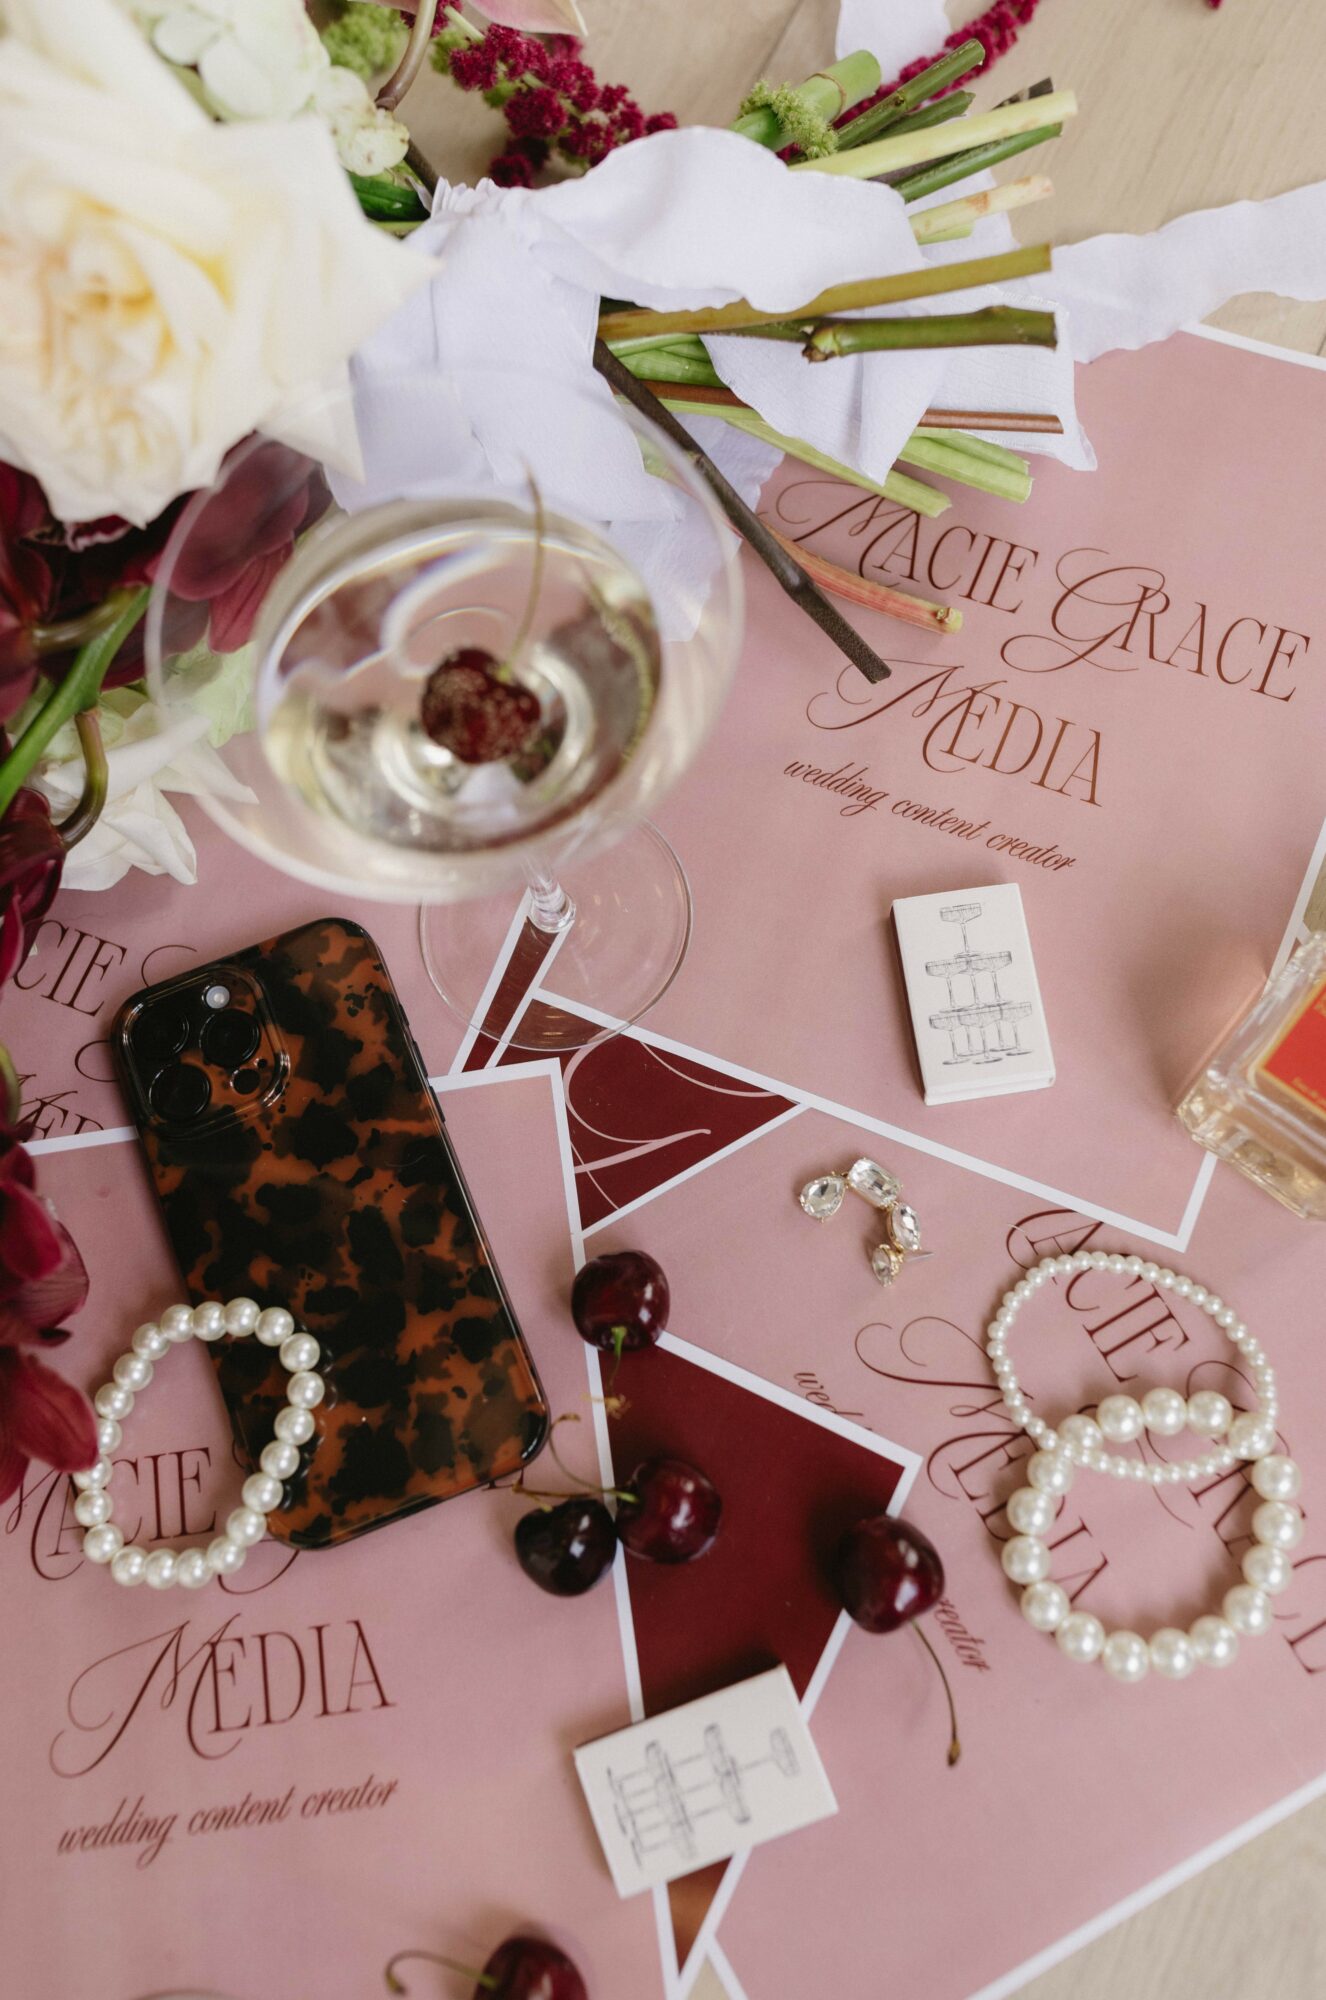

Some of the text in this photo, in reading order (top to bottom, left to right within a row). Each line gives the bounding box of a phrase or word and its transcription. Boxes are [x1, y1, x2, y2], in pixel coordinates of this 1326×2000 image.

[757, 481, 1310, 702] MACIE GRACE
[806, 658, 1103, 807] MEDIA
[784, 762, 1076, 872] wedding content creator
[12, 919, 127, 1016] CIE
[934, 1598, 991, 1672] reator
[49, 1613, 397, 1778] MEDIA
[57, 1774, 399, 1869] wedding content creator
